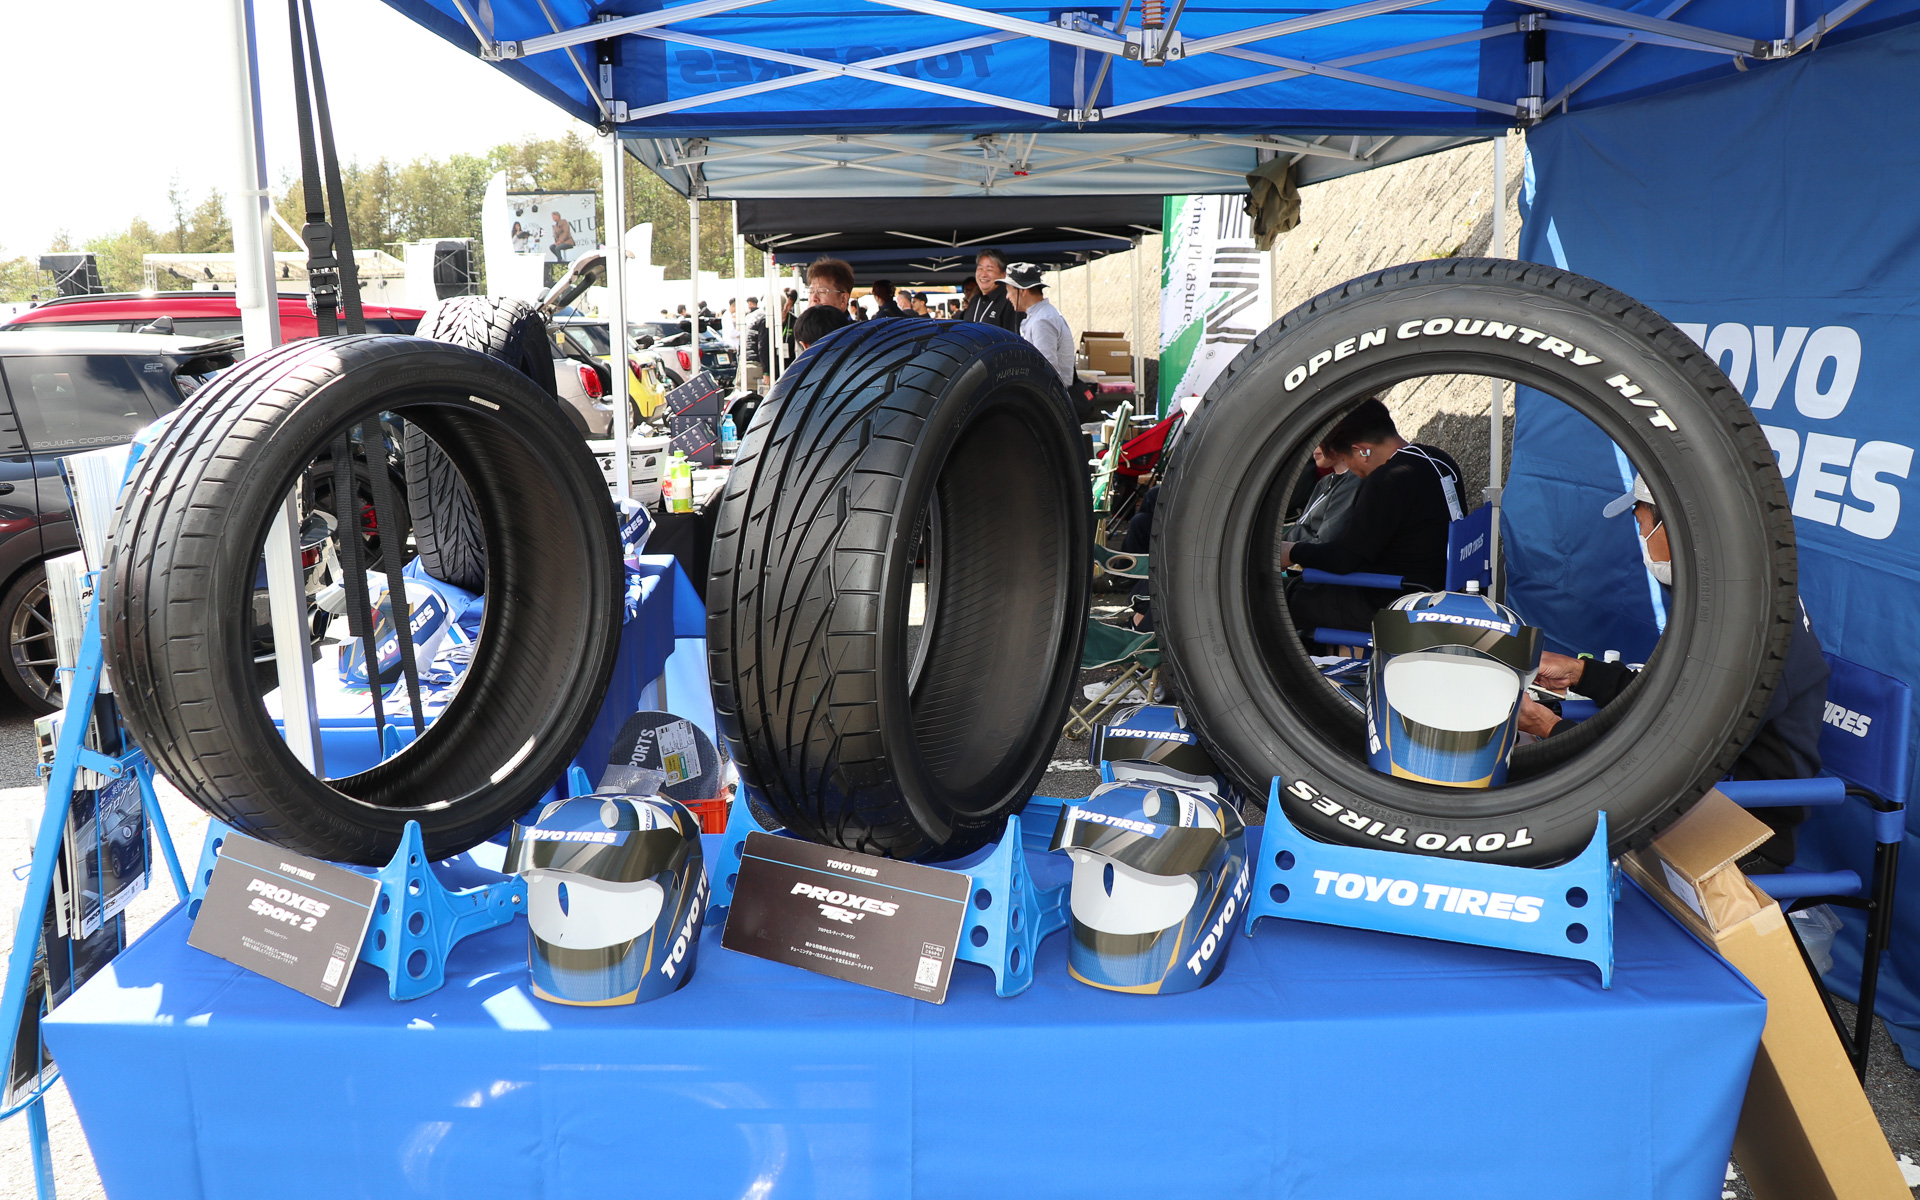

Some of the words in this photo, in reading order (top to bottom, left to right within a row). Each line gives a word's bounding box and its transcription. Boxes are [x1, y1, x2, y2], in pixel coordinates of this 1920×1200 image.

[1183, 243, 1202, 323] Pleasure
[143, 362, 164, 370] GP
[1283, 328, 1386, 393] OPEN
[1396, 317, 1603, 367] COUNTRY
[1604, 371, 1679, 433] H/T
[33, 438, 77, 449] SOUWA
[1416, 612, 1464, 623] TOYO
[1465, 617, 1512, 633] TIRES
[1109, 728, 1148, 740] TOYO
[1147, 731, 1191, 743] TIRES
[1067, 809, 1108, 826] TOYO
[1105, 816, 1157, 836] TIRES
[1286, 780, 1408, 845] TIRES
[523, 828, 567, 841] TOYO
[565, 831, 617, 844] TIRES
[1413, 827, 1533, 852] TOYO
[280, 862, 299, 875] TOYO
[296, 867, 316, 881] TIRES
[826, 859, 851, 871] TOYO
[850, 864, 878, 877] TIRES
[246, 878, 330, 918] PROXES
[790, 882, 899, 917] PROXES
[1313, 869, 1418, 906] TOYO
[1418, 882, 1545, 923] TIRES
[248, 898, 301, 926] Sport
[299, 917, 318, 933] 2
[661, 896, 700, 979] TOYO
[1187, 900, 1236, 976] TOYO
